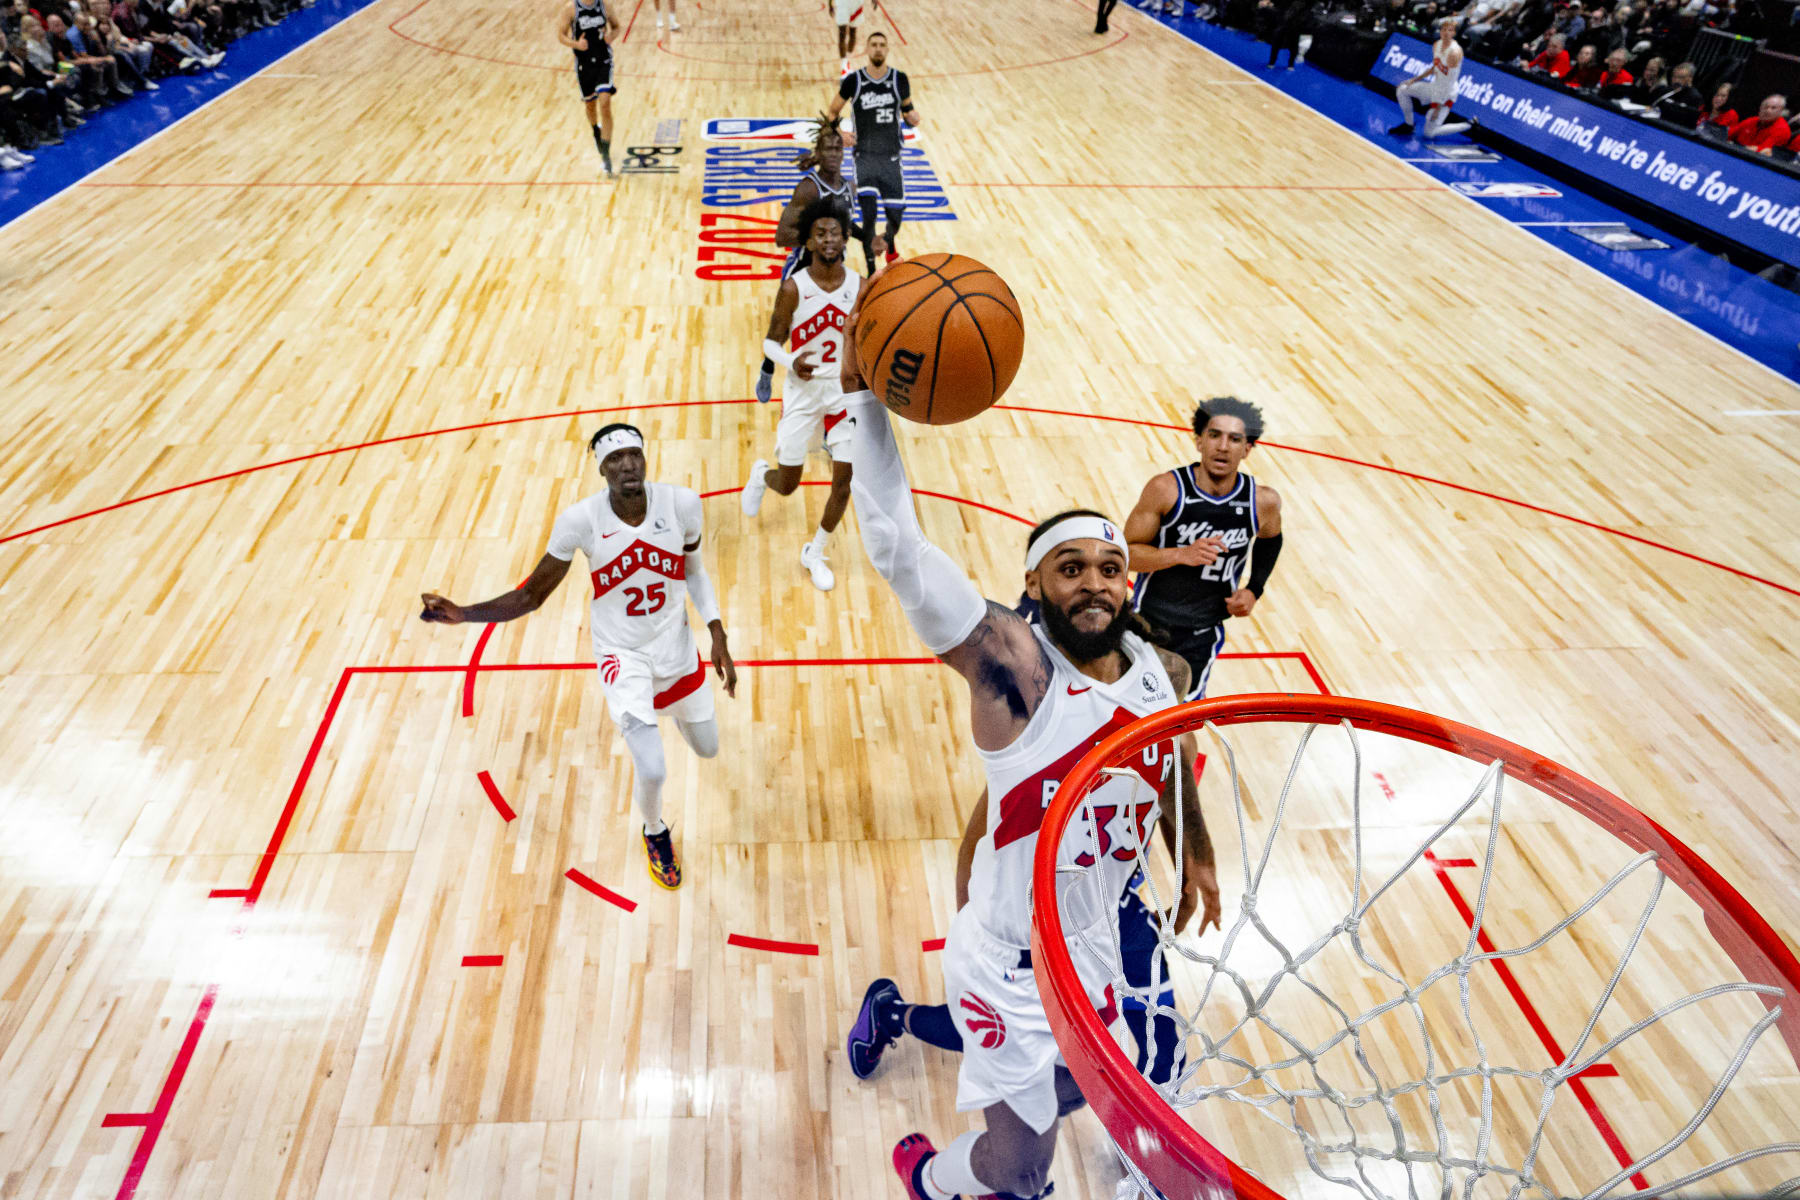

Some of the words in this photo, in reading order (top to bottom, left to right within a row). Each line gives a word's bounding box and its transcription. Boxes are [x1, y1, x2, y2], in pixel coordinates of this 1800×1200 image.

[875, 108, 894, 123] 25
[1384, 45, 1408, 68] For
[1458, 74, 1494, 105] that's
[1492, 93, 1515, 114] on
[1512, 98, 1554, 129] their
[1548, 116, 1600, 153] mind,
[1596, 136, 1649, 169] we're
[1645, 151, 1699, 191] here
[1696, 170, 1740, 205] for
[701, 146, 813, 207] SERIES
[695, 212, 794, 280] 2025
[821, 340, 837, 363] 2
[622, 581, 667, 617] 25
[1142, 695, 1156, 704] Sun
[1156, 690, 1168, 700] Life
[1074, 800, 1155, 868] 33
